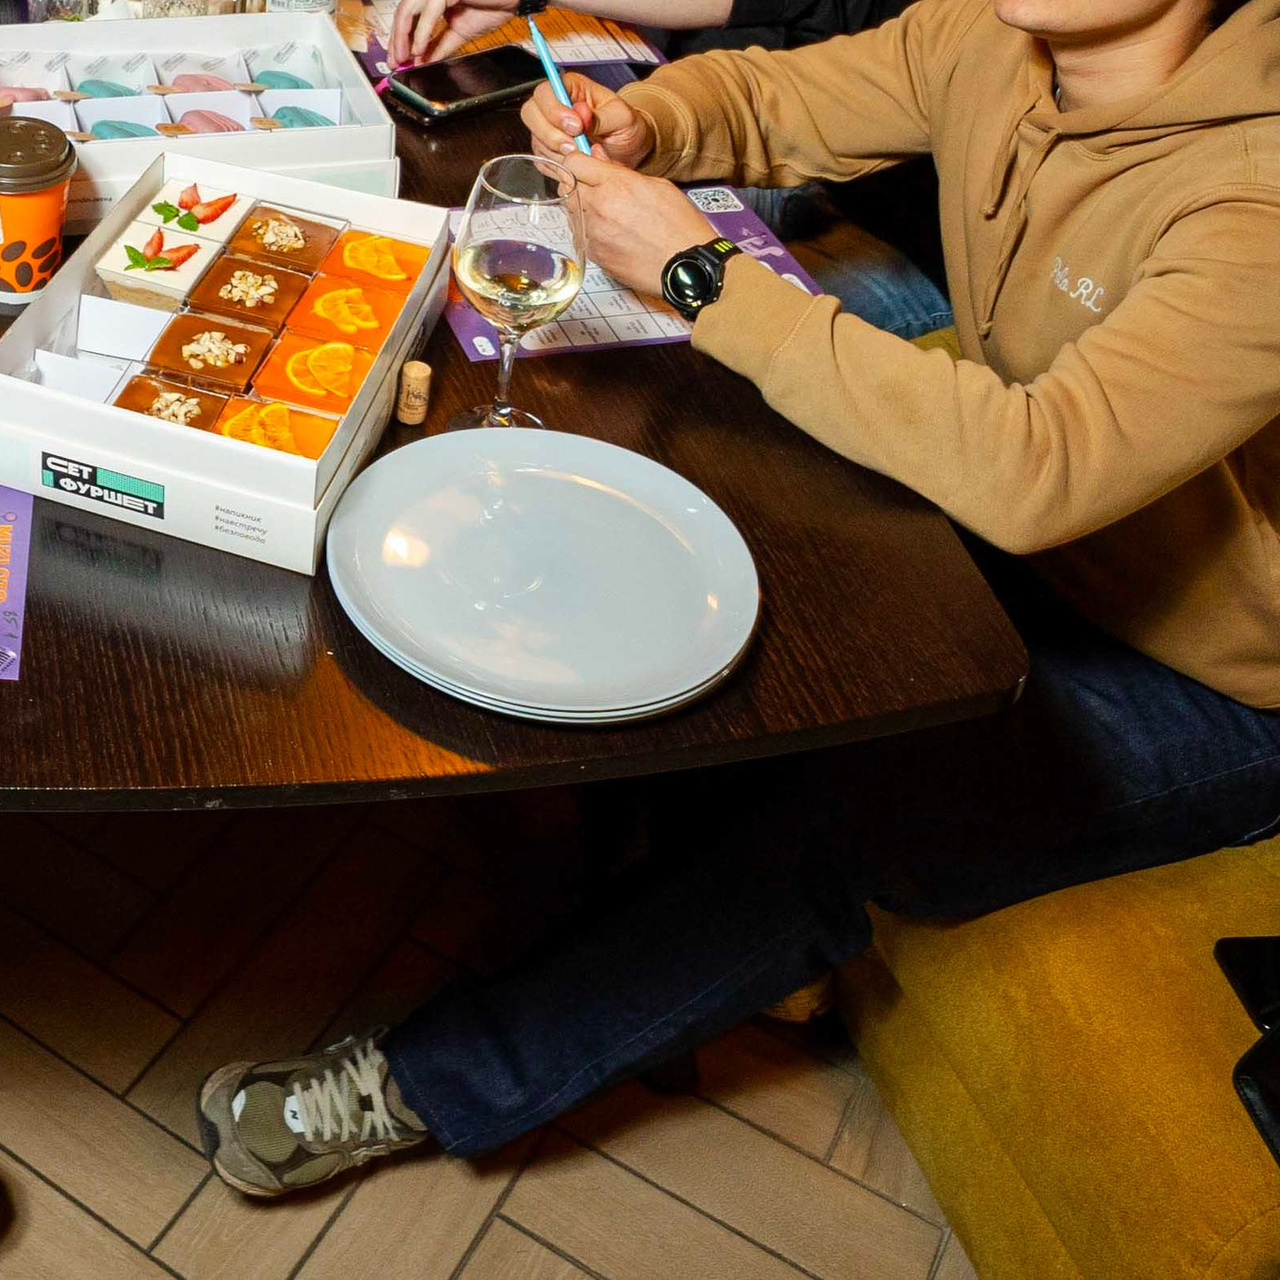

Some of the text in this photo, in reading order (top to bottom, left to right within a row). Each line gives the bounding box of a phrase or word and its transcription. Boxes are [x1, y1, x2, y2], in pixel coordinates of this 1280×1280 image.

[1070, 277, 1105, 312] RL
[46, 457, 92, 480] СЕТ
[58, 476, 158, 516] ФУРШЕТ
